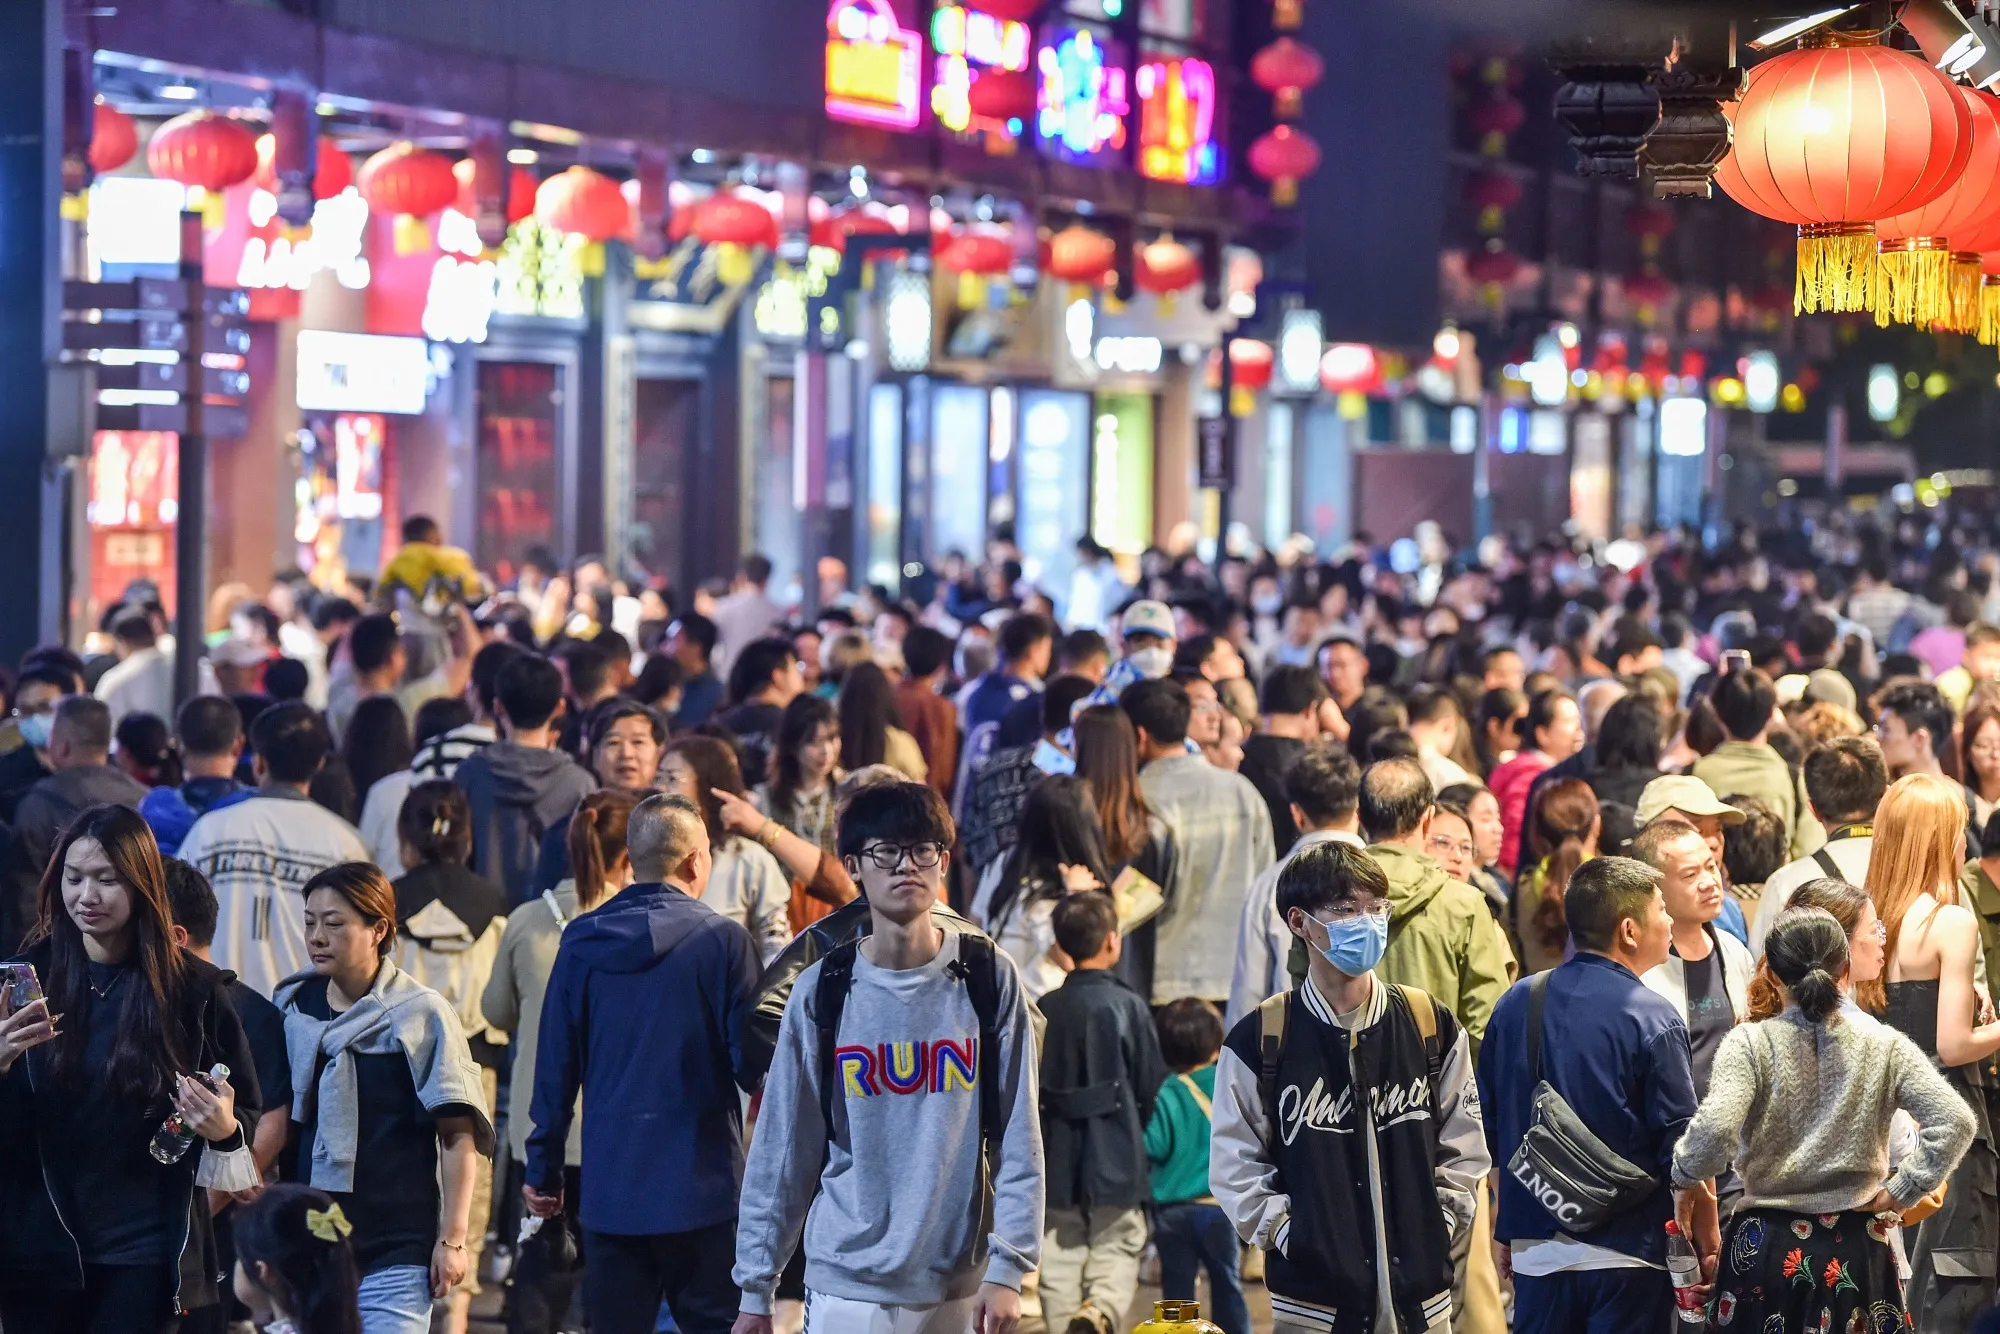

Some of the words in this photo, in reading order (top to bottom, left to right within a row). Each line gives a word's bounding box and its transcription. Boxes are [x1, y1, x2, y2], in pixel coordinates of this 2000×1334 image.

[1850, 826, 1873, 837] Niko
[834, 1038, 980, 1098] RUN
[1513, 1161, 1582, 1224] LNOC
